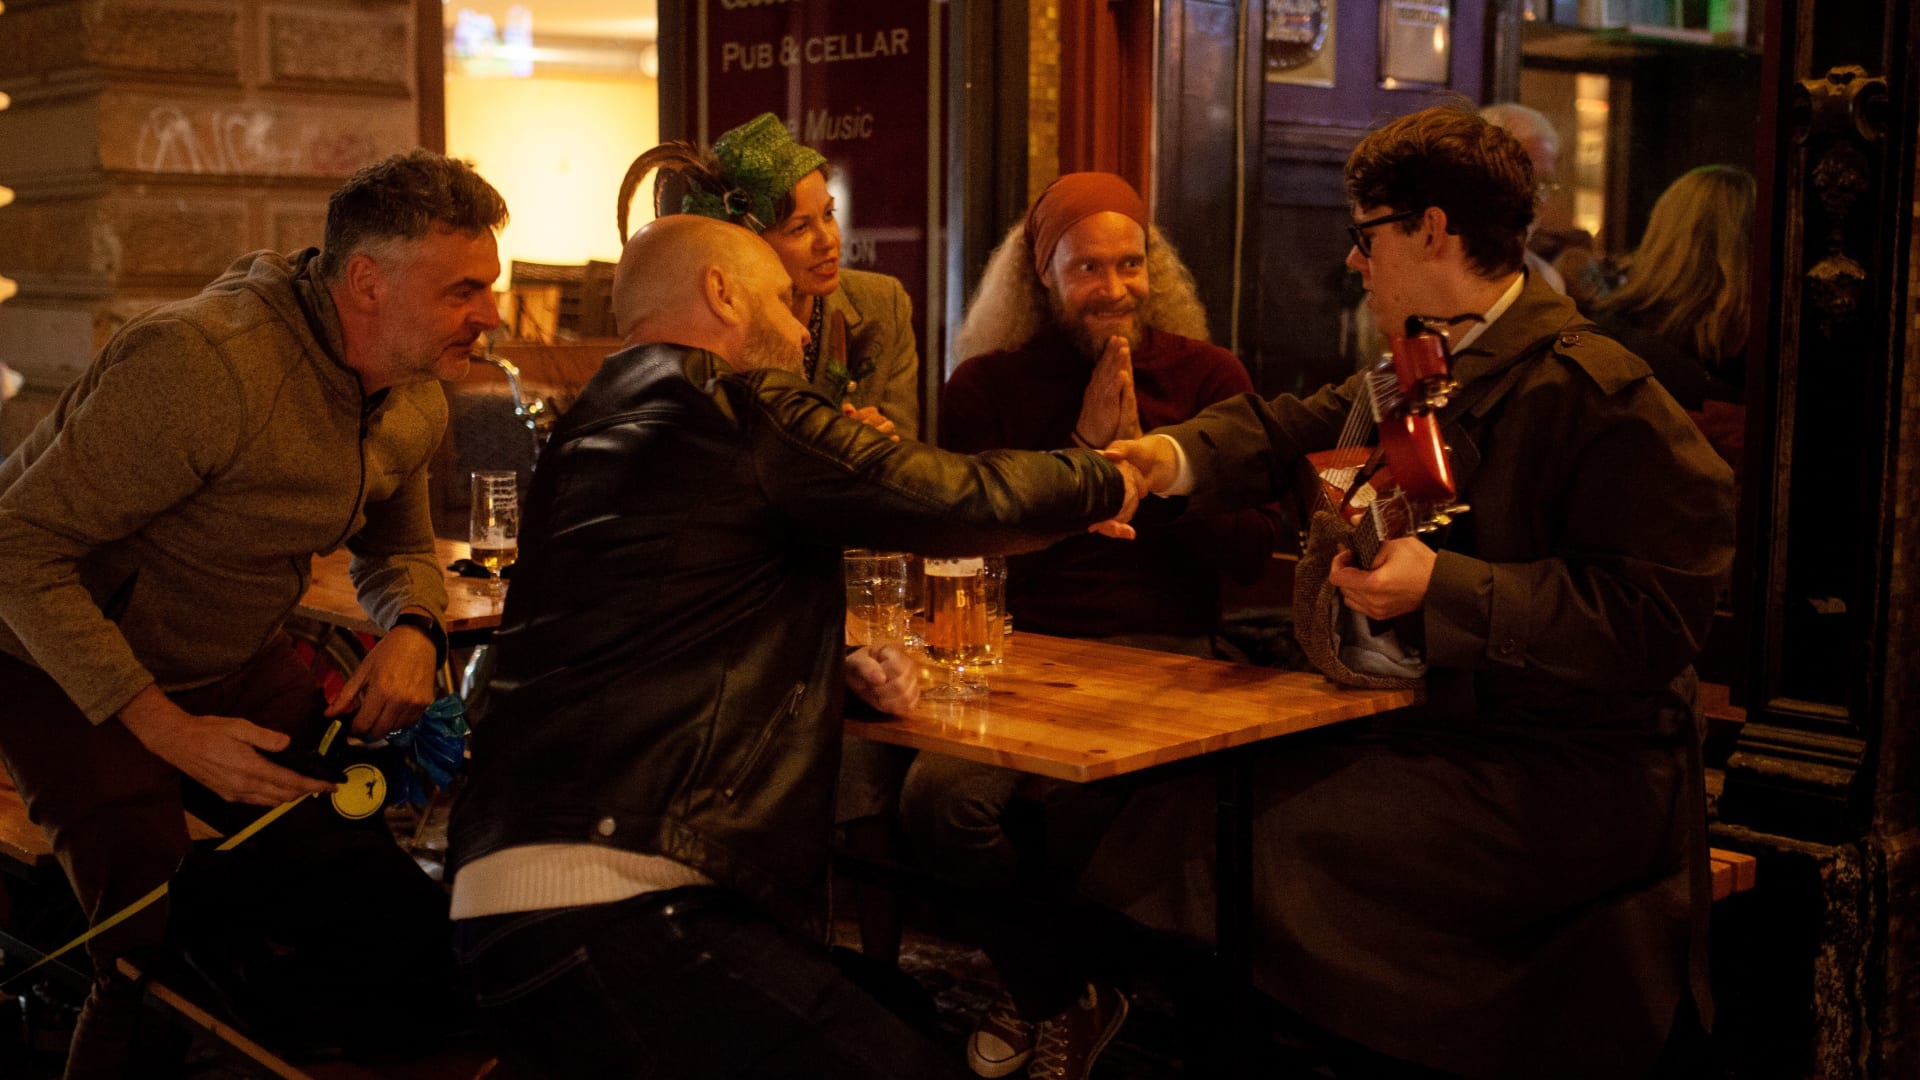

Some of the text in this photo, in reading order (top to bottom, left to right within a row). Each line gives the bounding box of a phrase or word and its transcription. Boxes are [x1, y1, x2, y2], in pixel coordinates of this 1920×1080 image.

[721, 28, 909, 72] PUB & CELLAR
